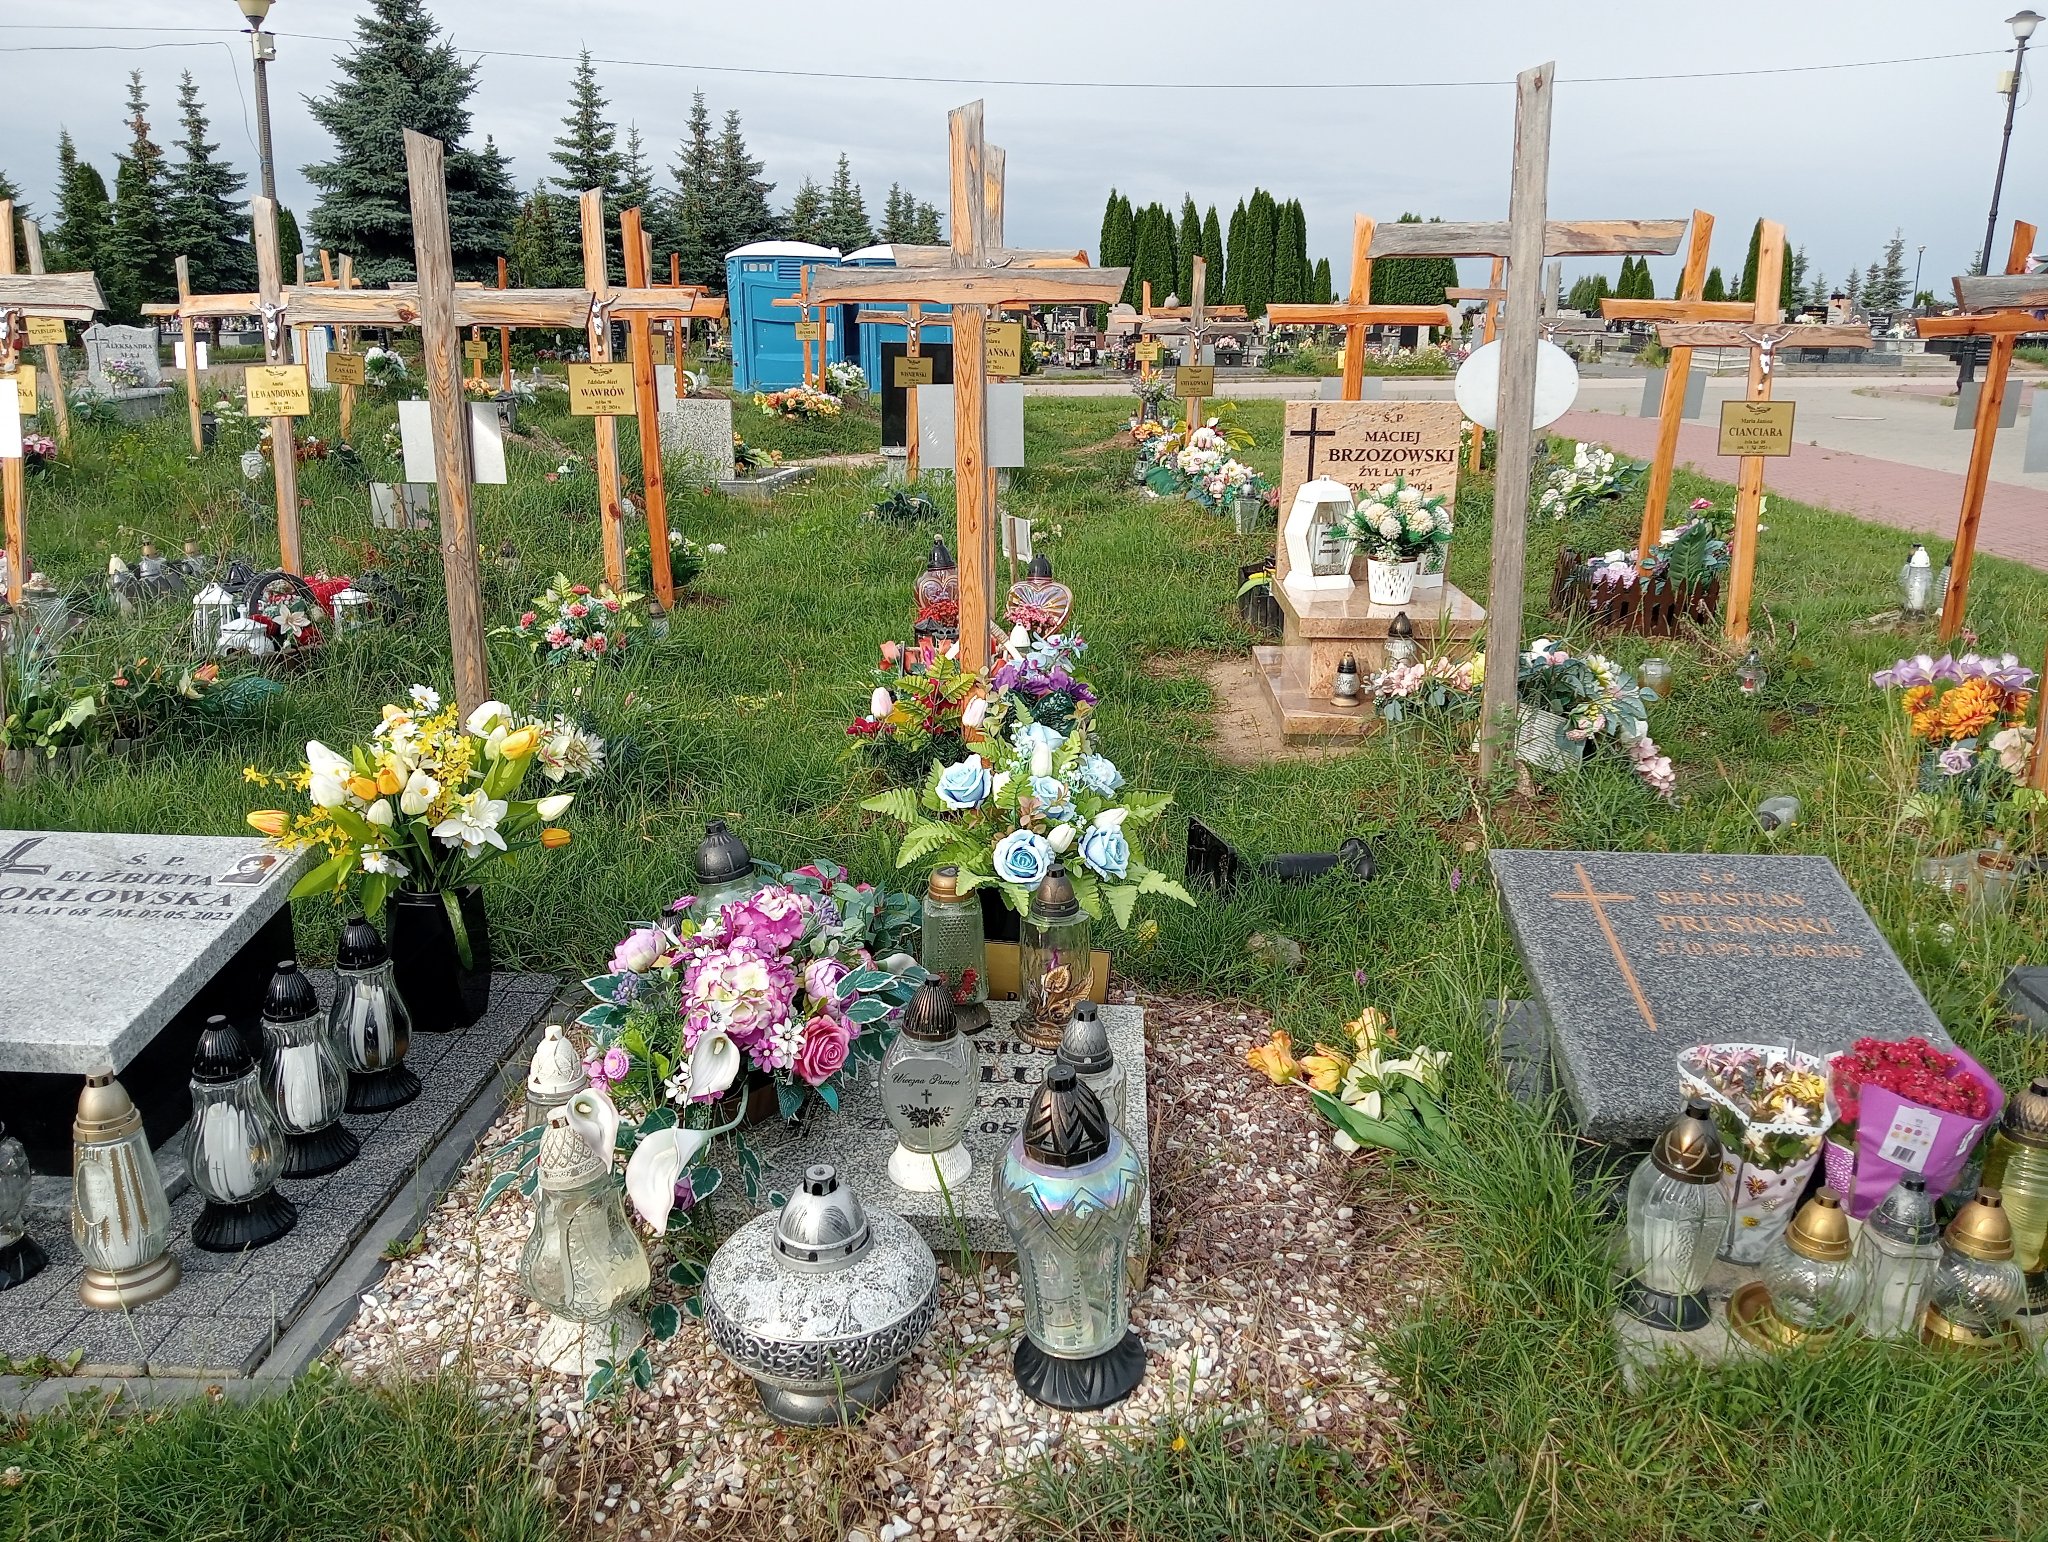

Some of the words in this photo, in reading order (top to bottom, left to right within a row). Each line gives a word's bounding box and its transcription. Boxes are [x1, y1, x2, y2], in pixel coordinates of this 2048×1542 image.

[251, 389, 305, 399] LEWANDOWSKA
[580, 385, 626, 397] WAWRÓW
[1364, 430, 1421, 445] MACIEJ
[1729, 427, 1783, 437] CIANCIARA
[1328, 447, 1456, 463] BRZOZOWSKI
[1358, 465, 1382, 477] ŻYŁ
[1384, 468, 1407, 477] LAT
[1408, 468, 1421, 477] 47
[55, 869, 213, 887] ELŻBIETA
[0, 886, 232, 907] ORŁOWSKA
[1655, 890, 1806, 907] SEBASTIAN
[24, 905, 68, 916] LAT
[68, 907, 90, 917] 68
[1656, 912, 1836, 935] PRUSIŃSKI
[890, 1071, 926, 1086] Wieczna
[926, 1072, 961, 1087] Pamięć
